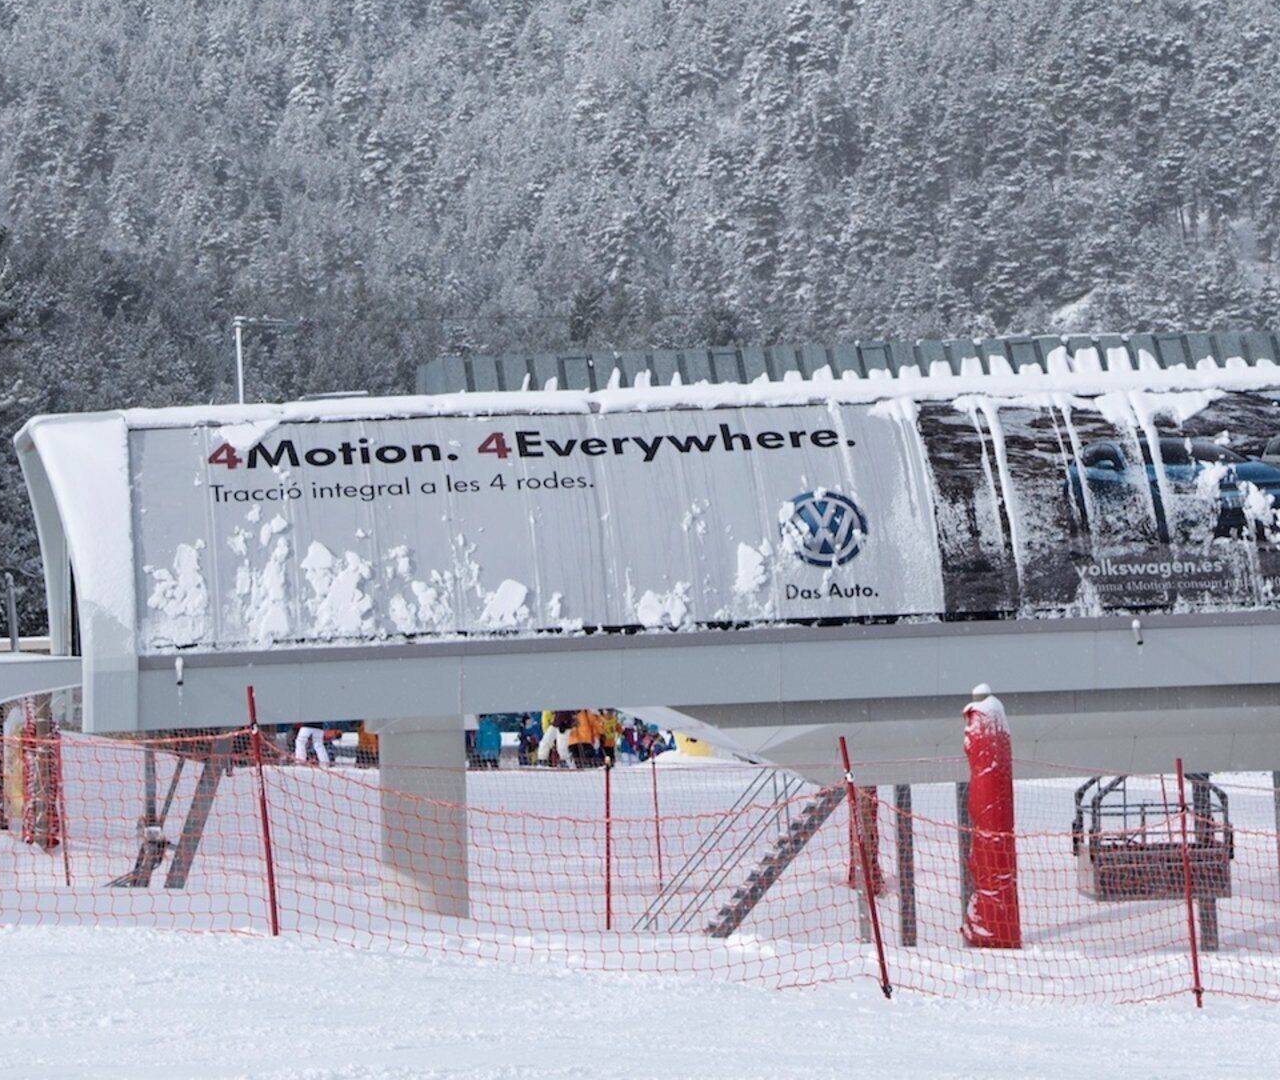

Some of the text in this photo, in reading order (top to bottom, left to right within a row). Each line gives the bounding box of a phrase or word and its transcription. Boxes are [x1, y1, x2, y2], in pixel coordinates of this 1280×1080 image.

[207, 423, 856, 469] 4Motion. 4Everywhere.
[210, 470, 594, 503] Tracció integral a les 4 rodes.
[1074, 558, 1223, 579] volkswagen.es
[785, 582, 879, 601] Das Auto.
